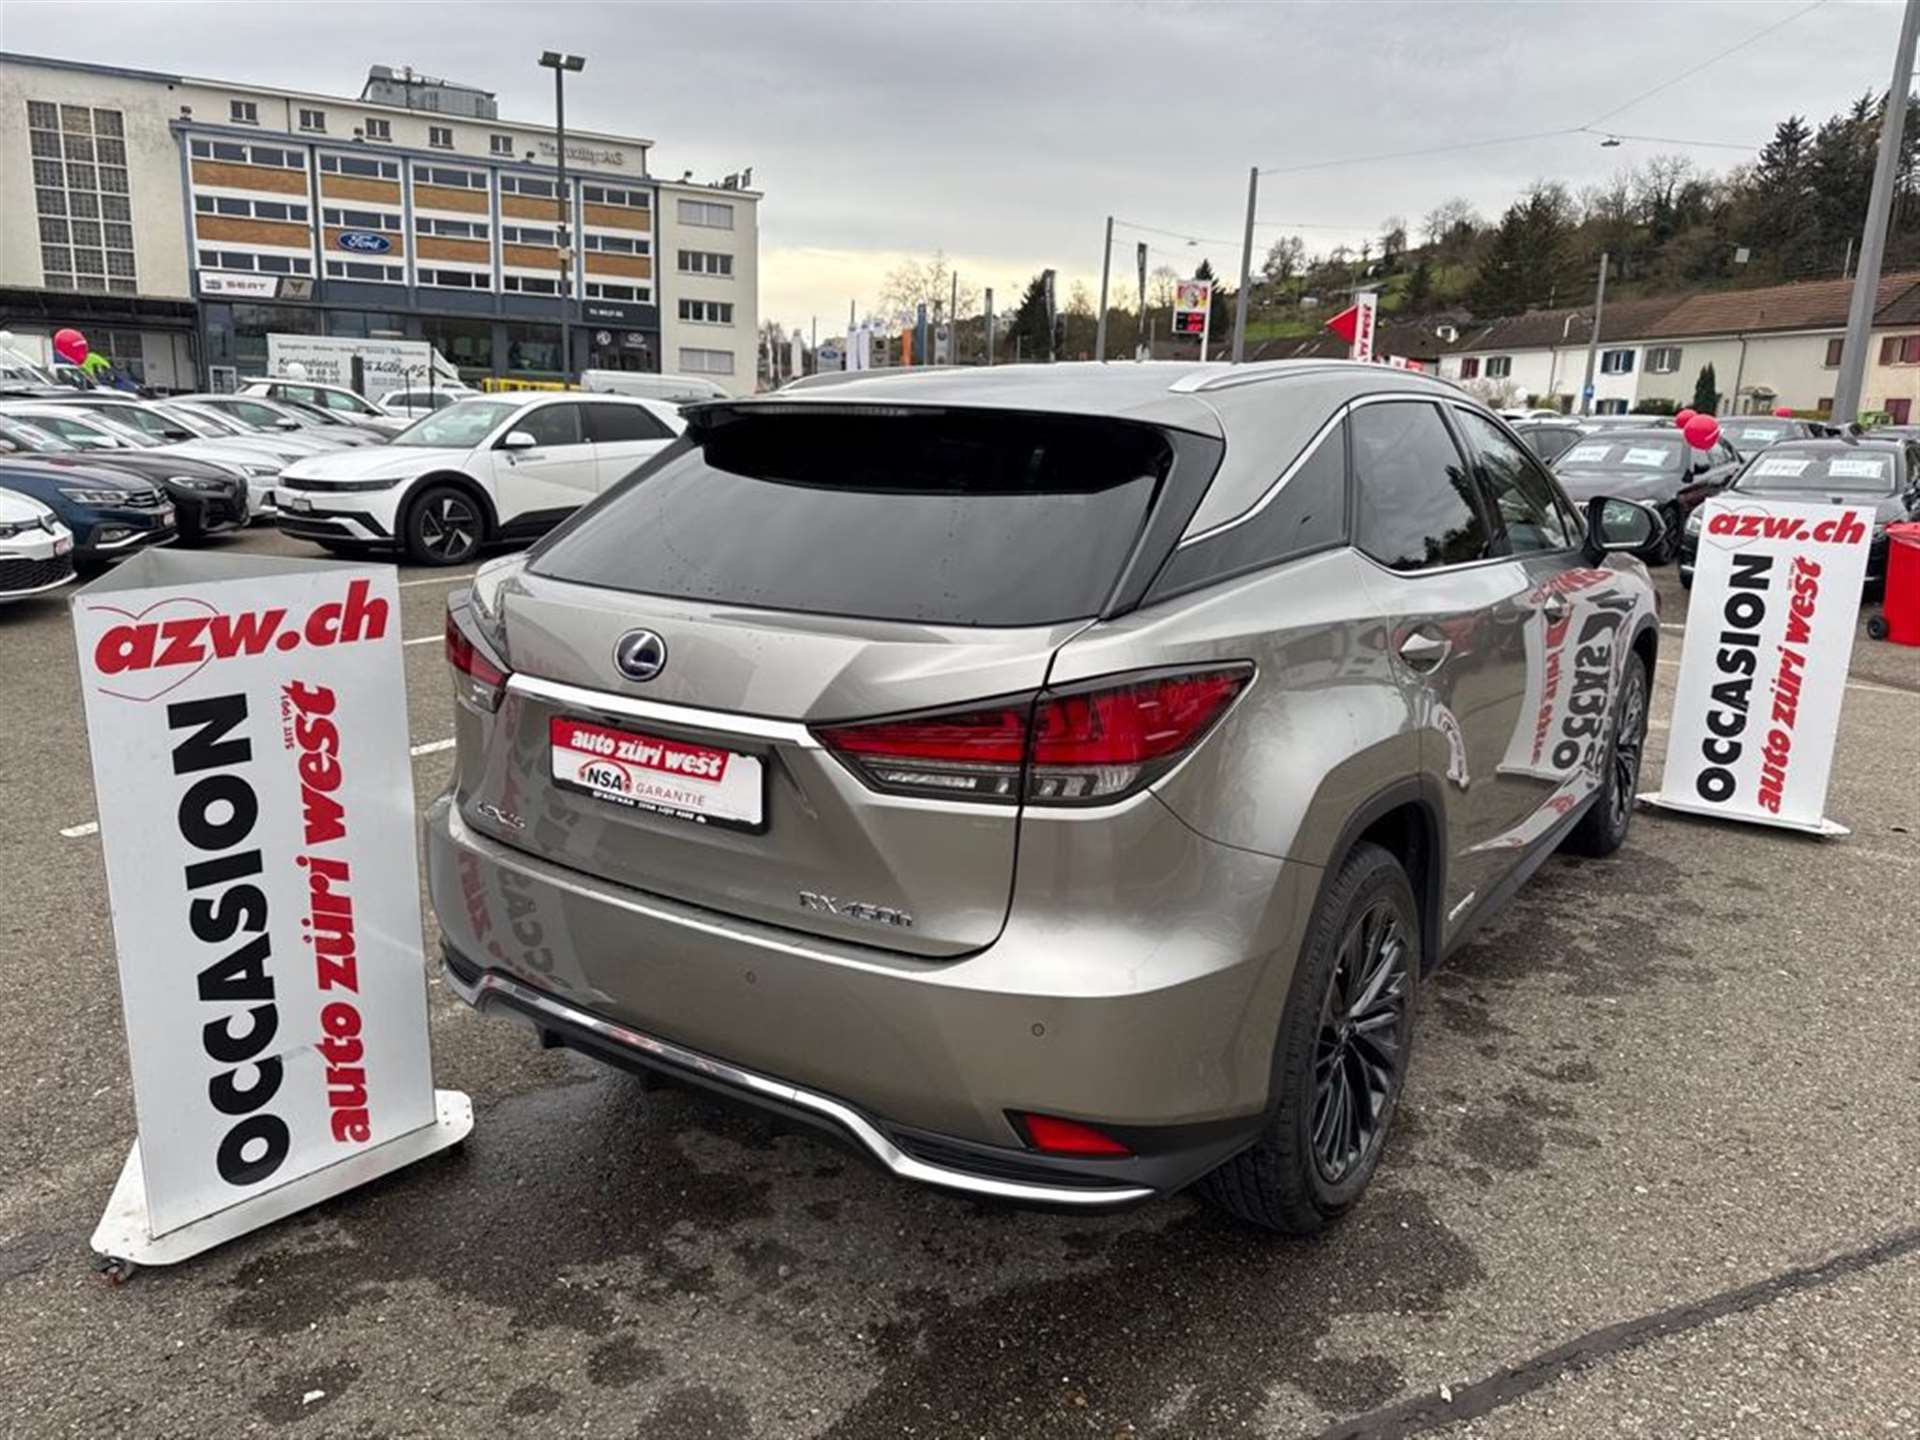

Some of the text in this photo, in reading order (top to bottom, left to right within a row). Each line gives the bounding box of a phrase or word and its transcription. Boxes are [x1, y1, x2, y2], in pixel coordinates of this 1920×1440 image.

[349, 234, 379, 249] Ford
[1707, 511, 1867, 544] azw.ch
[94, 579, 389, 674] azw.ch
[1696, 553, 1774, 803] OCCASION
[1757, 556, 1822, 814] auto züri west
[284, 727, 295, 750] SEIT
[571, 730, 722, 776] auto züri west
[587, 768, 622, 791] NSA
[635, 783, 705, 806] GARANTIE
[281, 679, 371, 1144] auto züri west
[166, 692, 290, 1187] OCCASION
